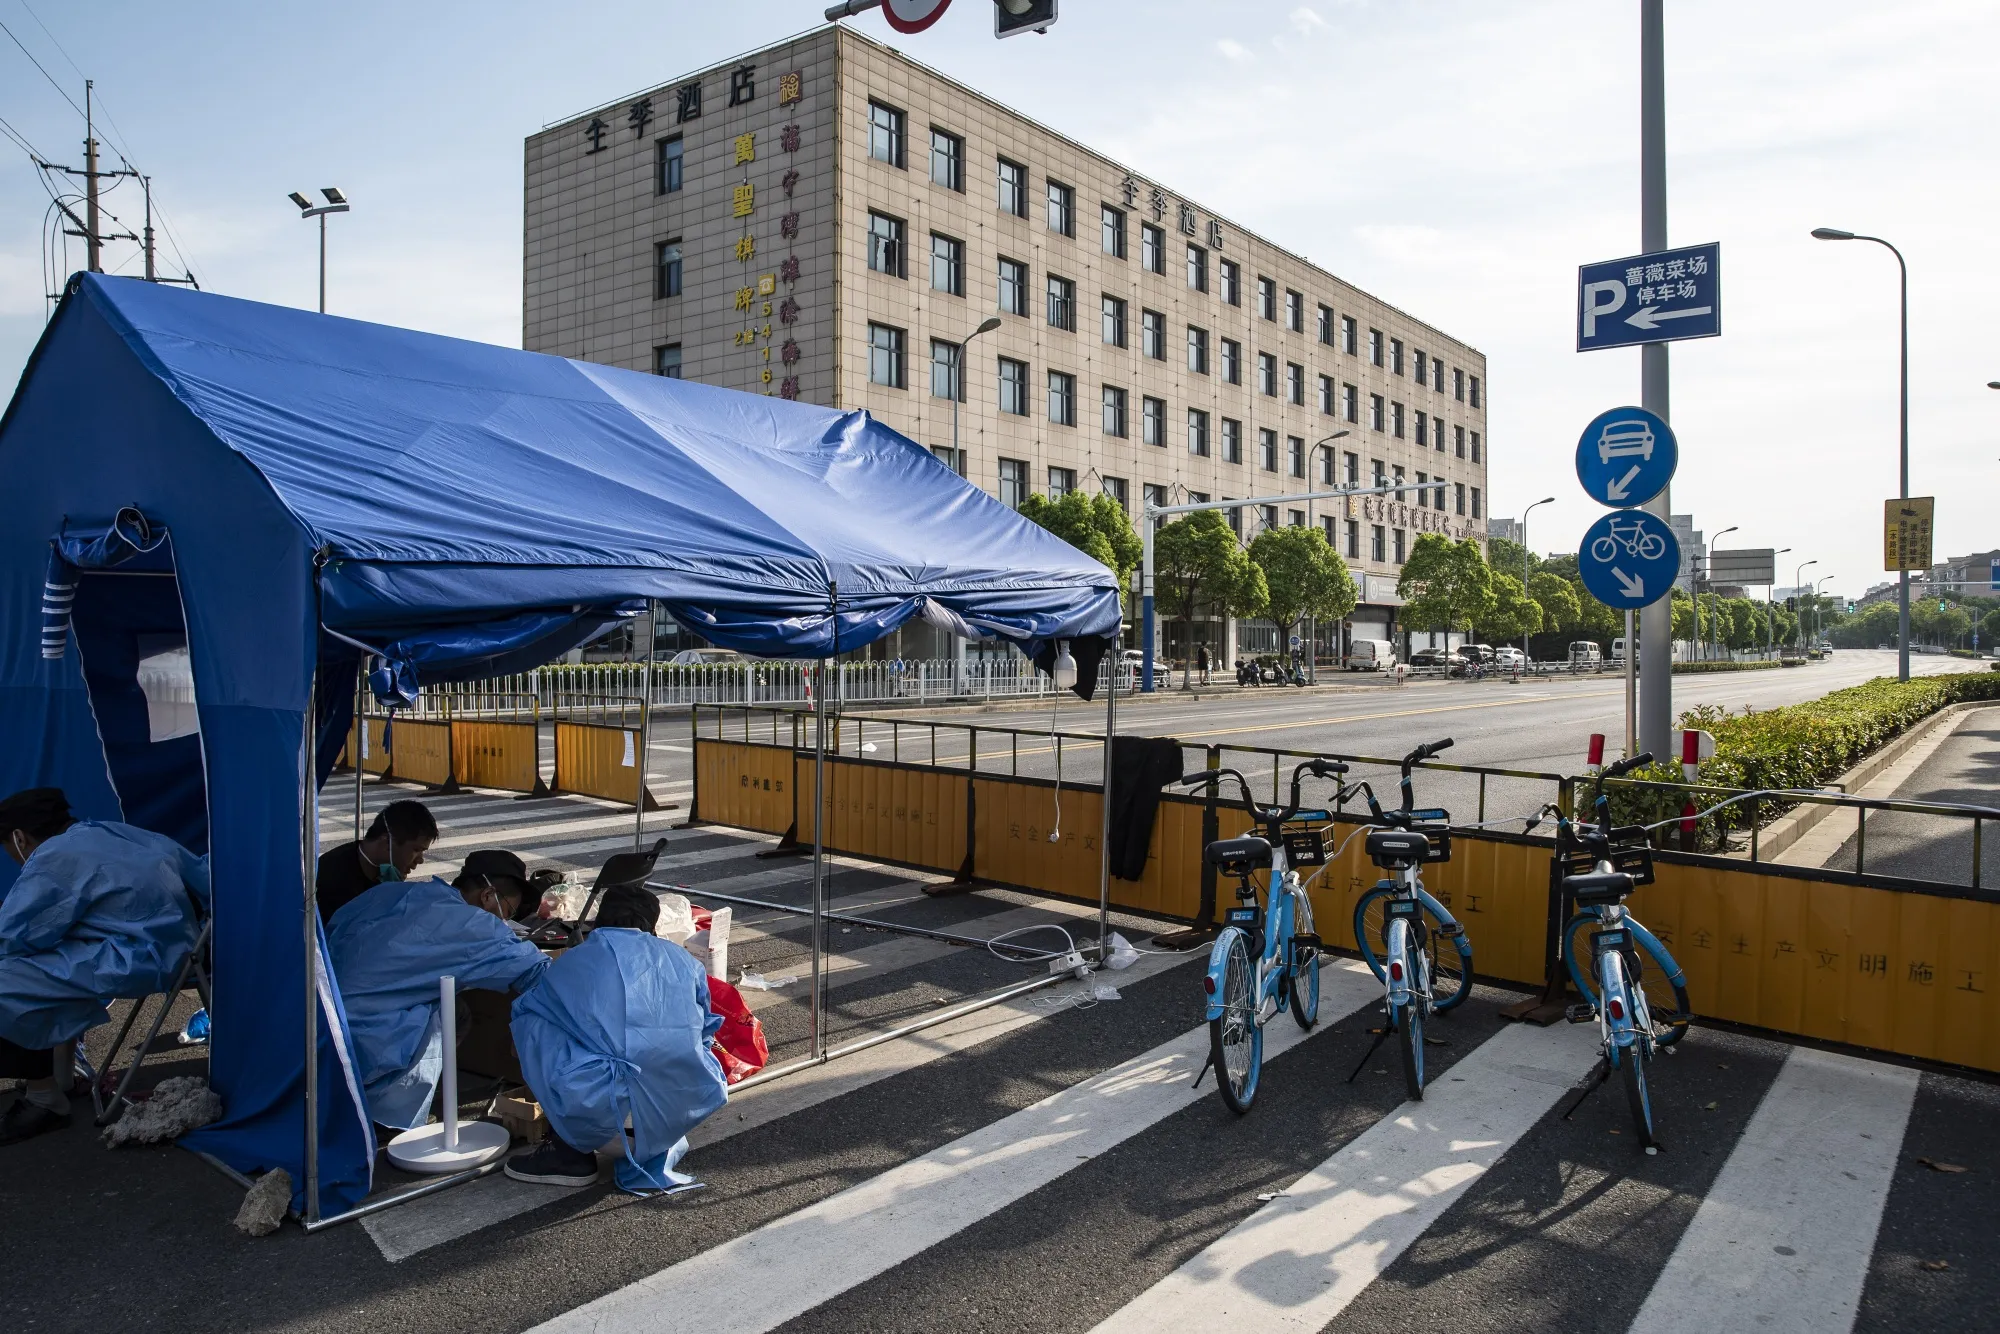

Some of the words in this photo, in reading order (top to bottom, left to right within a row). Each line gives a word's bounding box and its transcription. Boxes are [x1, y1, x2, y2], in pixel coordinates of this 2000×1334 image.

[585, 64, 757, 155] 全季酒店
[1123, 176, 1224, 250] 全季酒店
[1625, 255, 1708, 287] 蔷薇菜场
[1636, 279, 1697, 306] 停车场
[1584, 279, 1627, 338] P
[761, 301, 772, 396] 5416
[1651, 921, 1984, 994] 安全生产文明施工
